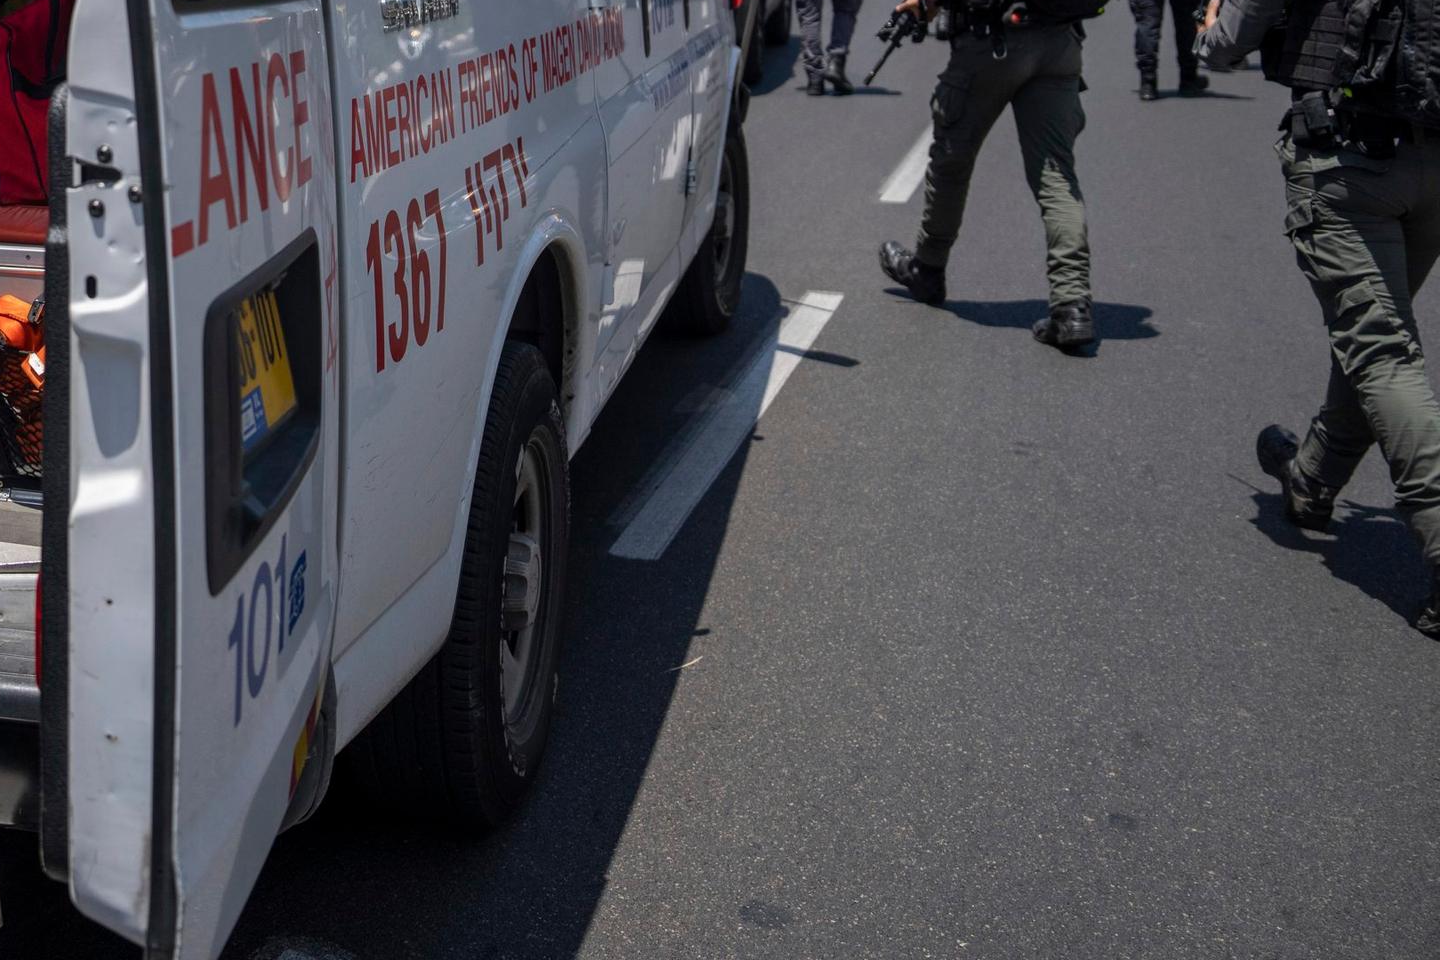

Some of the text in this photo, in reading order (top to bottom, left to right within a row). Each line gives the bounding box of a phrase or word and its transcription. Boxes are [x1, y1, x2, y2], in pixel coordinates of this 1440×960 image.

[350, 67, 456, 183] AMERICAN
[458, 43, 520, 134] FRIENDS
[522, 37, 538, 103] OF
[541, 22, 577, 93] MAGEN
[576, 14, 602, 74] DAVID
[366, 187, 447, 374] 1367
[228, 534, 287, 728] 101
